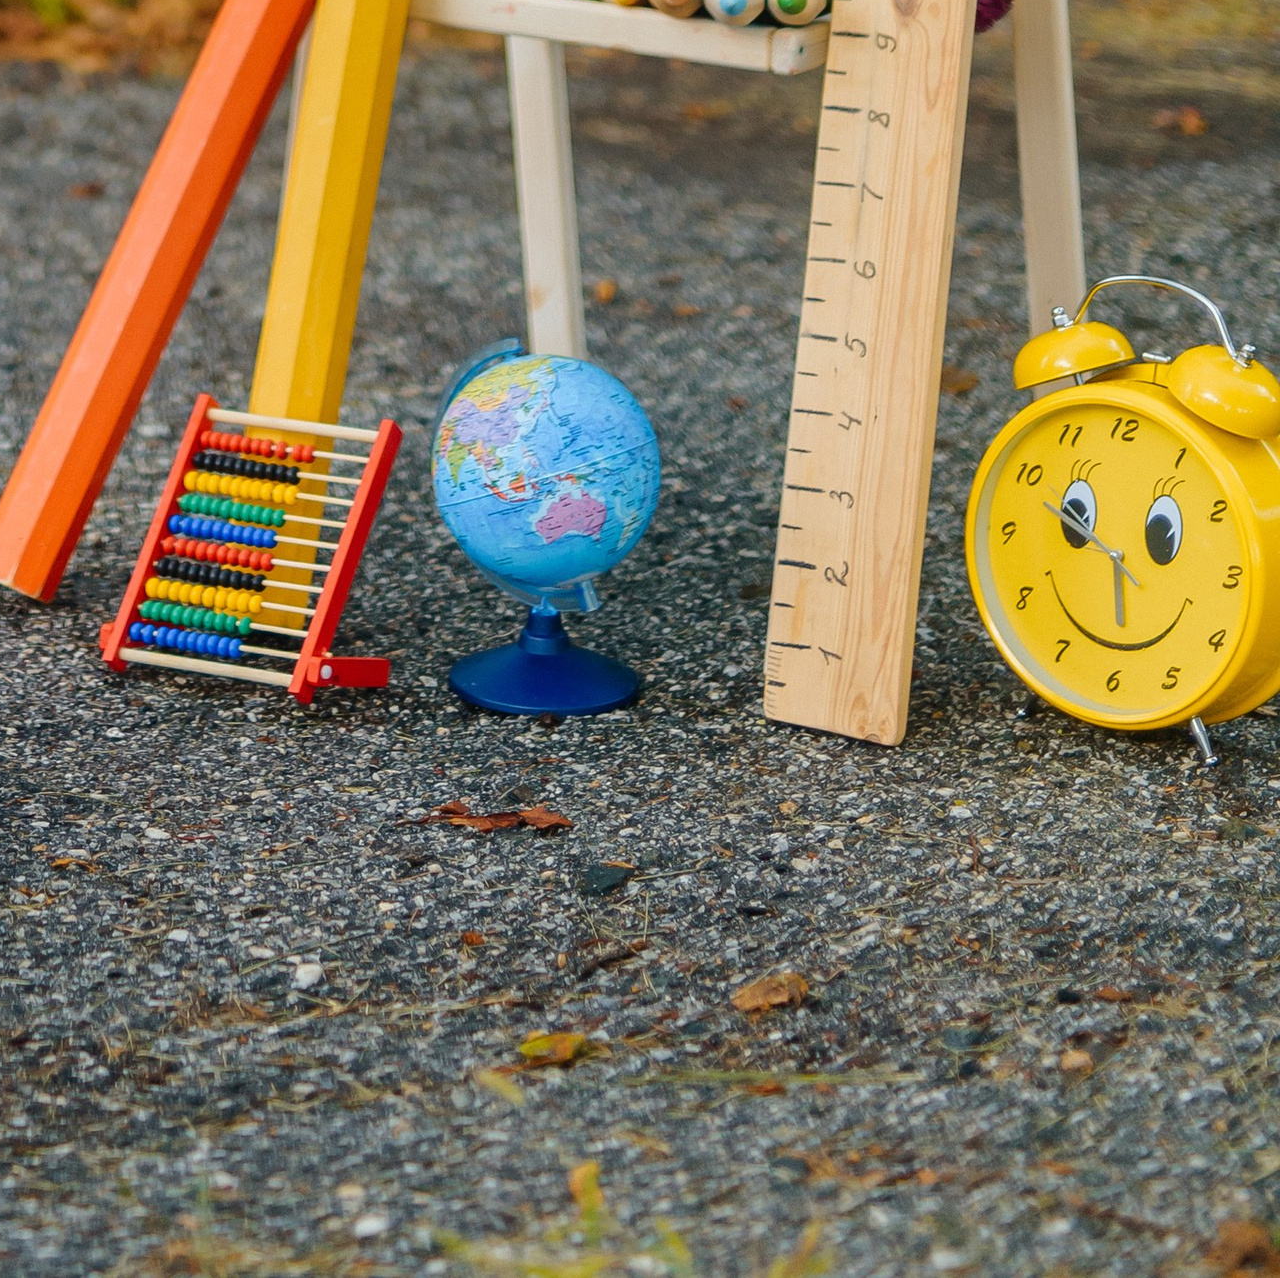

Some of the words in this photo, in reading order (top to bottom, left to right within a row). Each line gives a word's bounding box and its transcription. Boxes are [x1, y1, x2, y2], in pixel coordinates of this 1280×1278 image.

[876, 32, 897, 53] 9
[867, 109, 890, 129] 8
[861, 182, 884, 203] 7
[854, 260, 876, 279] 6
[844, 332, 867, 358] 5
[838, 410, 862, 431] 4
[1110, 417, 1140, 442] 12
[1058, 423, 1083, 447] 11
[1174, 447, 1187, 469] 1
[1016, 462, 1043, 486] 10
[829, 488, 855, 510] 3
[1209, 499, 1228, 523] 2
[1001, 521, 1017, 545] 9
[823, 560, 849, 587] 2
[1222, 565, 1243, 589] 3
[1015, 586, 1033, 610] 8
[1054, 639, 1071, 663] 7
[1208, 629, 1227, 652] 4
[817, 646, 842, 665] 1
[1105, 669, 1123, 693] 6
[1161, 666, 1181, 690] 5
